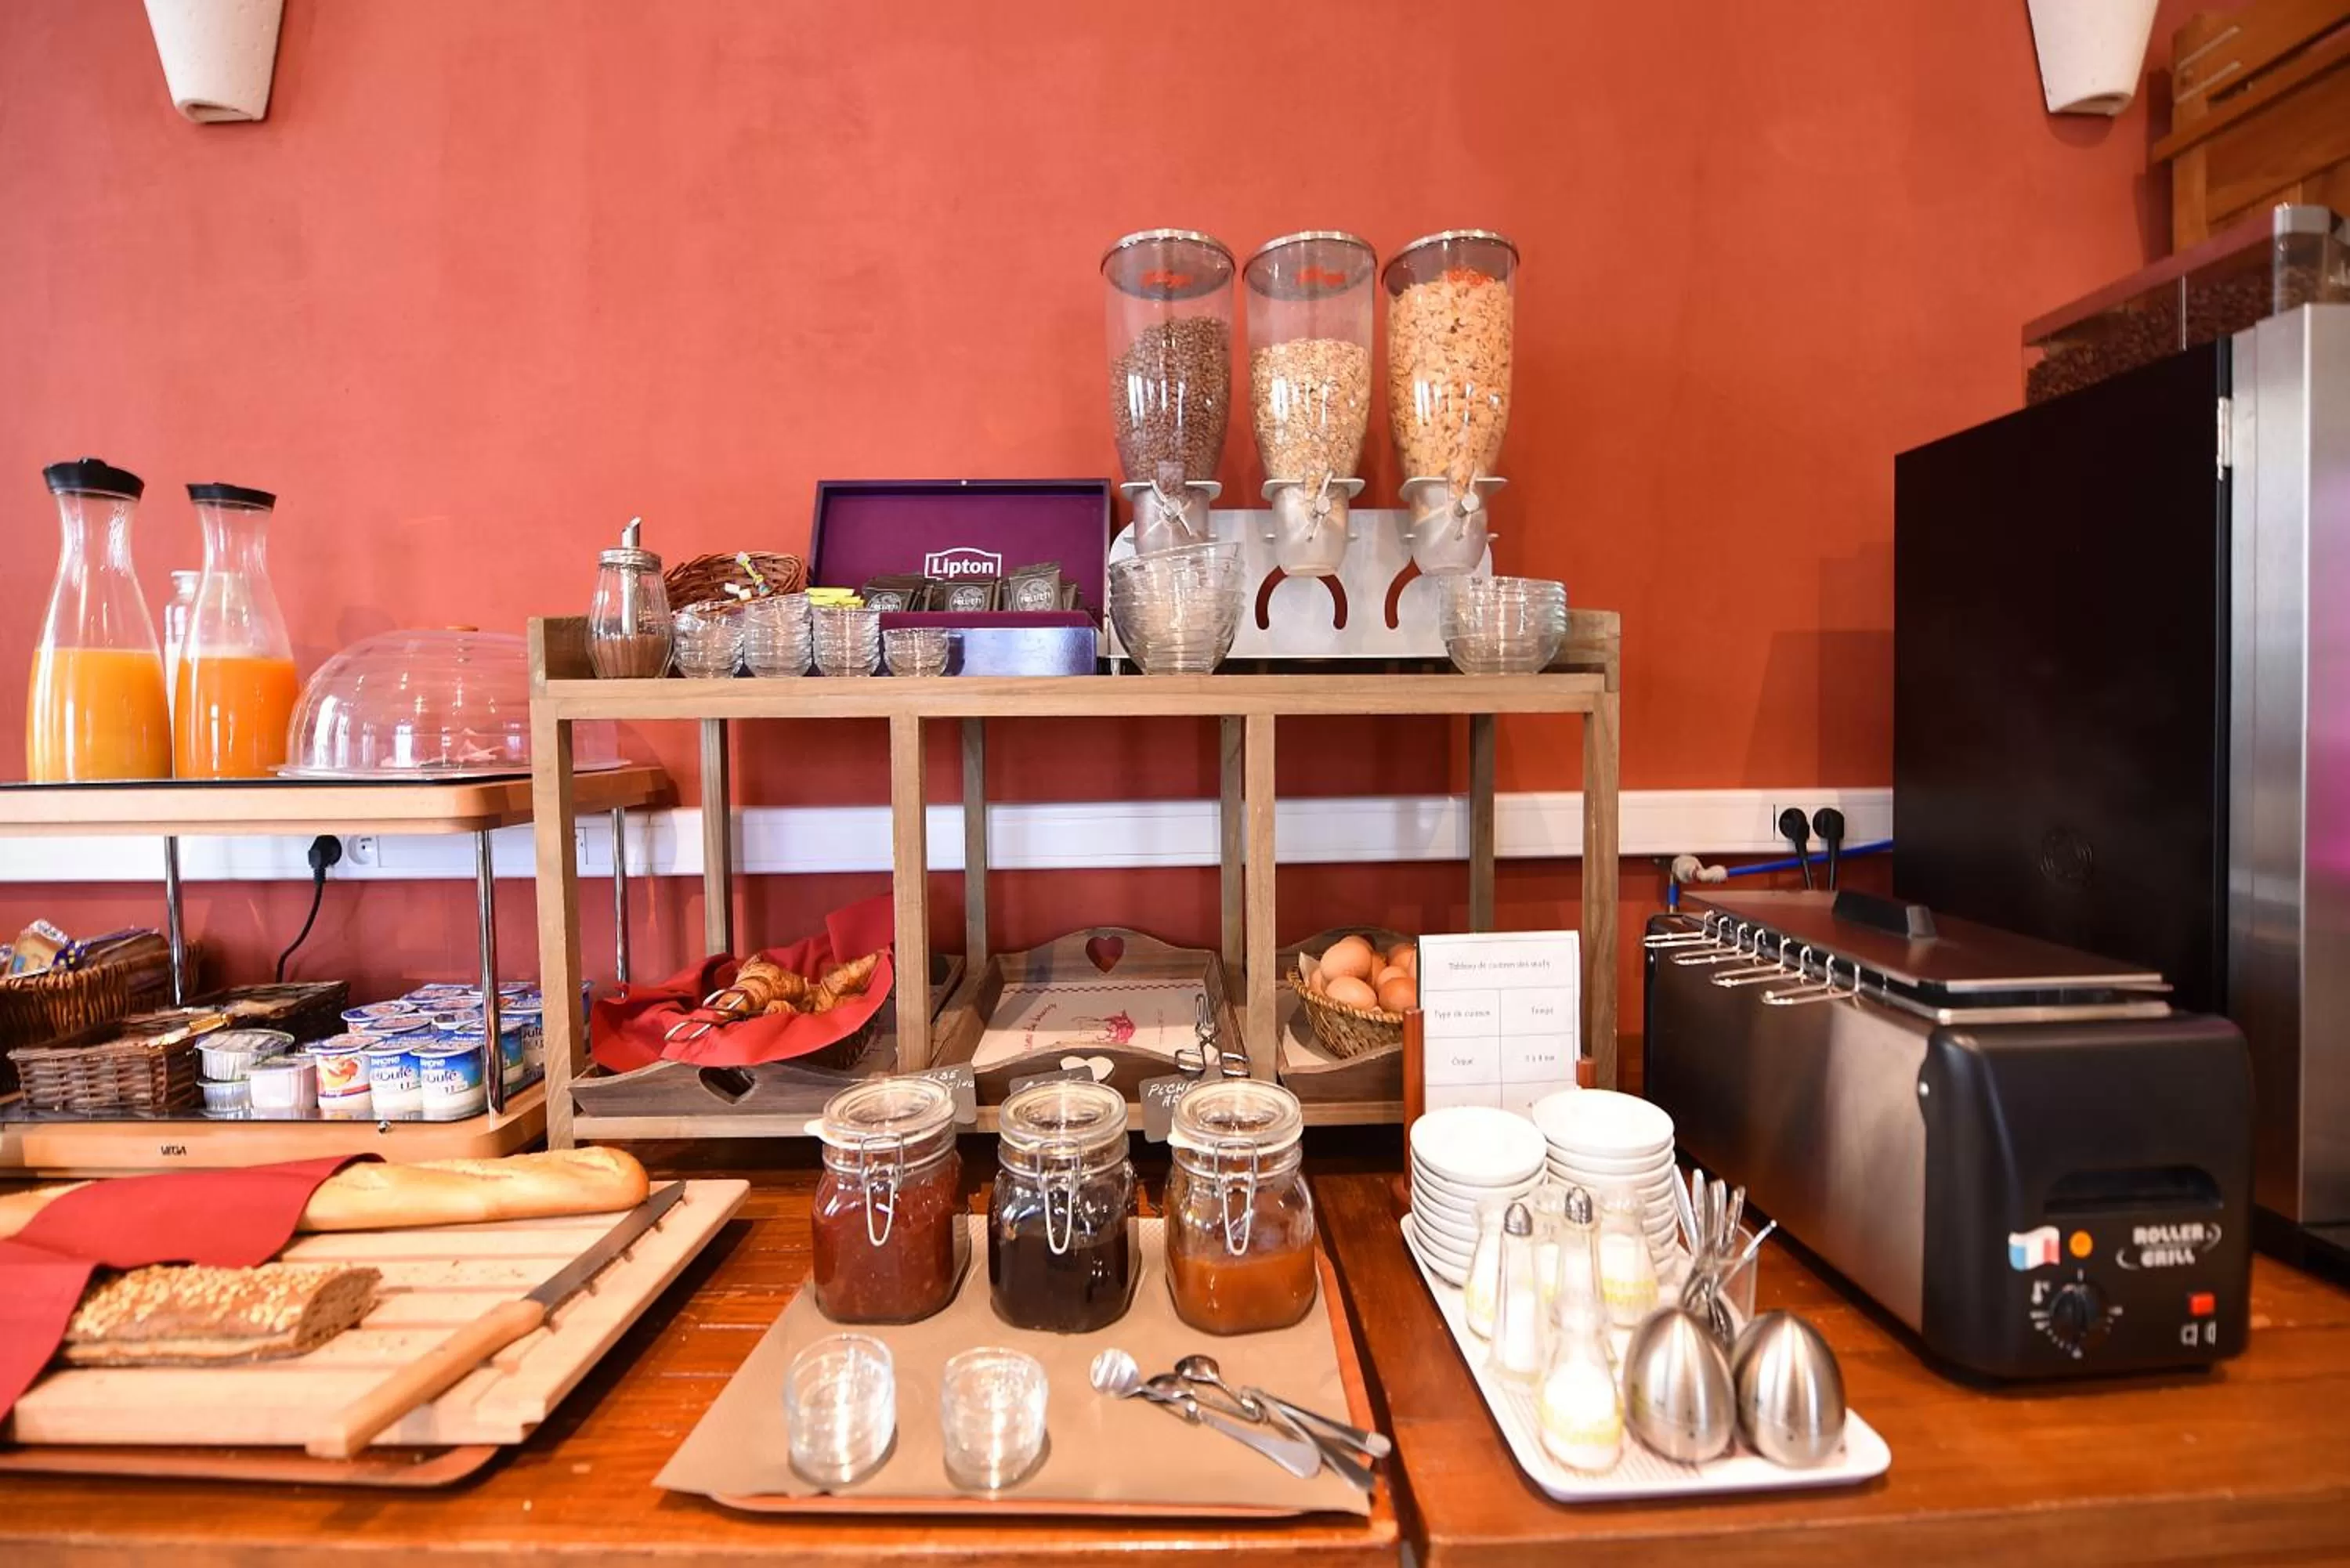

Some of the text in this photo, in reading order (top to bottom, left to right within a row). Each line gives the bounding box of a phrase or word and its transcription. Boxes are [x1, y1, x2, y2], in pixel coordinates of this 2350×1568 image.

[932, 557, 994, 578] Lipton
[2133, 1223, 2204, 1245] ROLLER
[2140, 1248, 2196, 1268] GRILL
